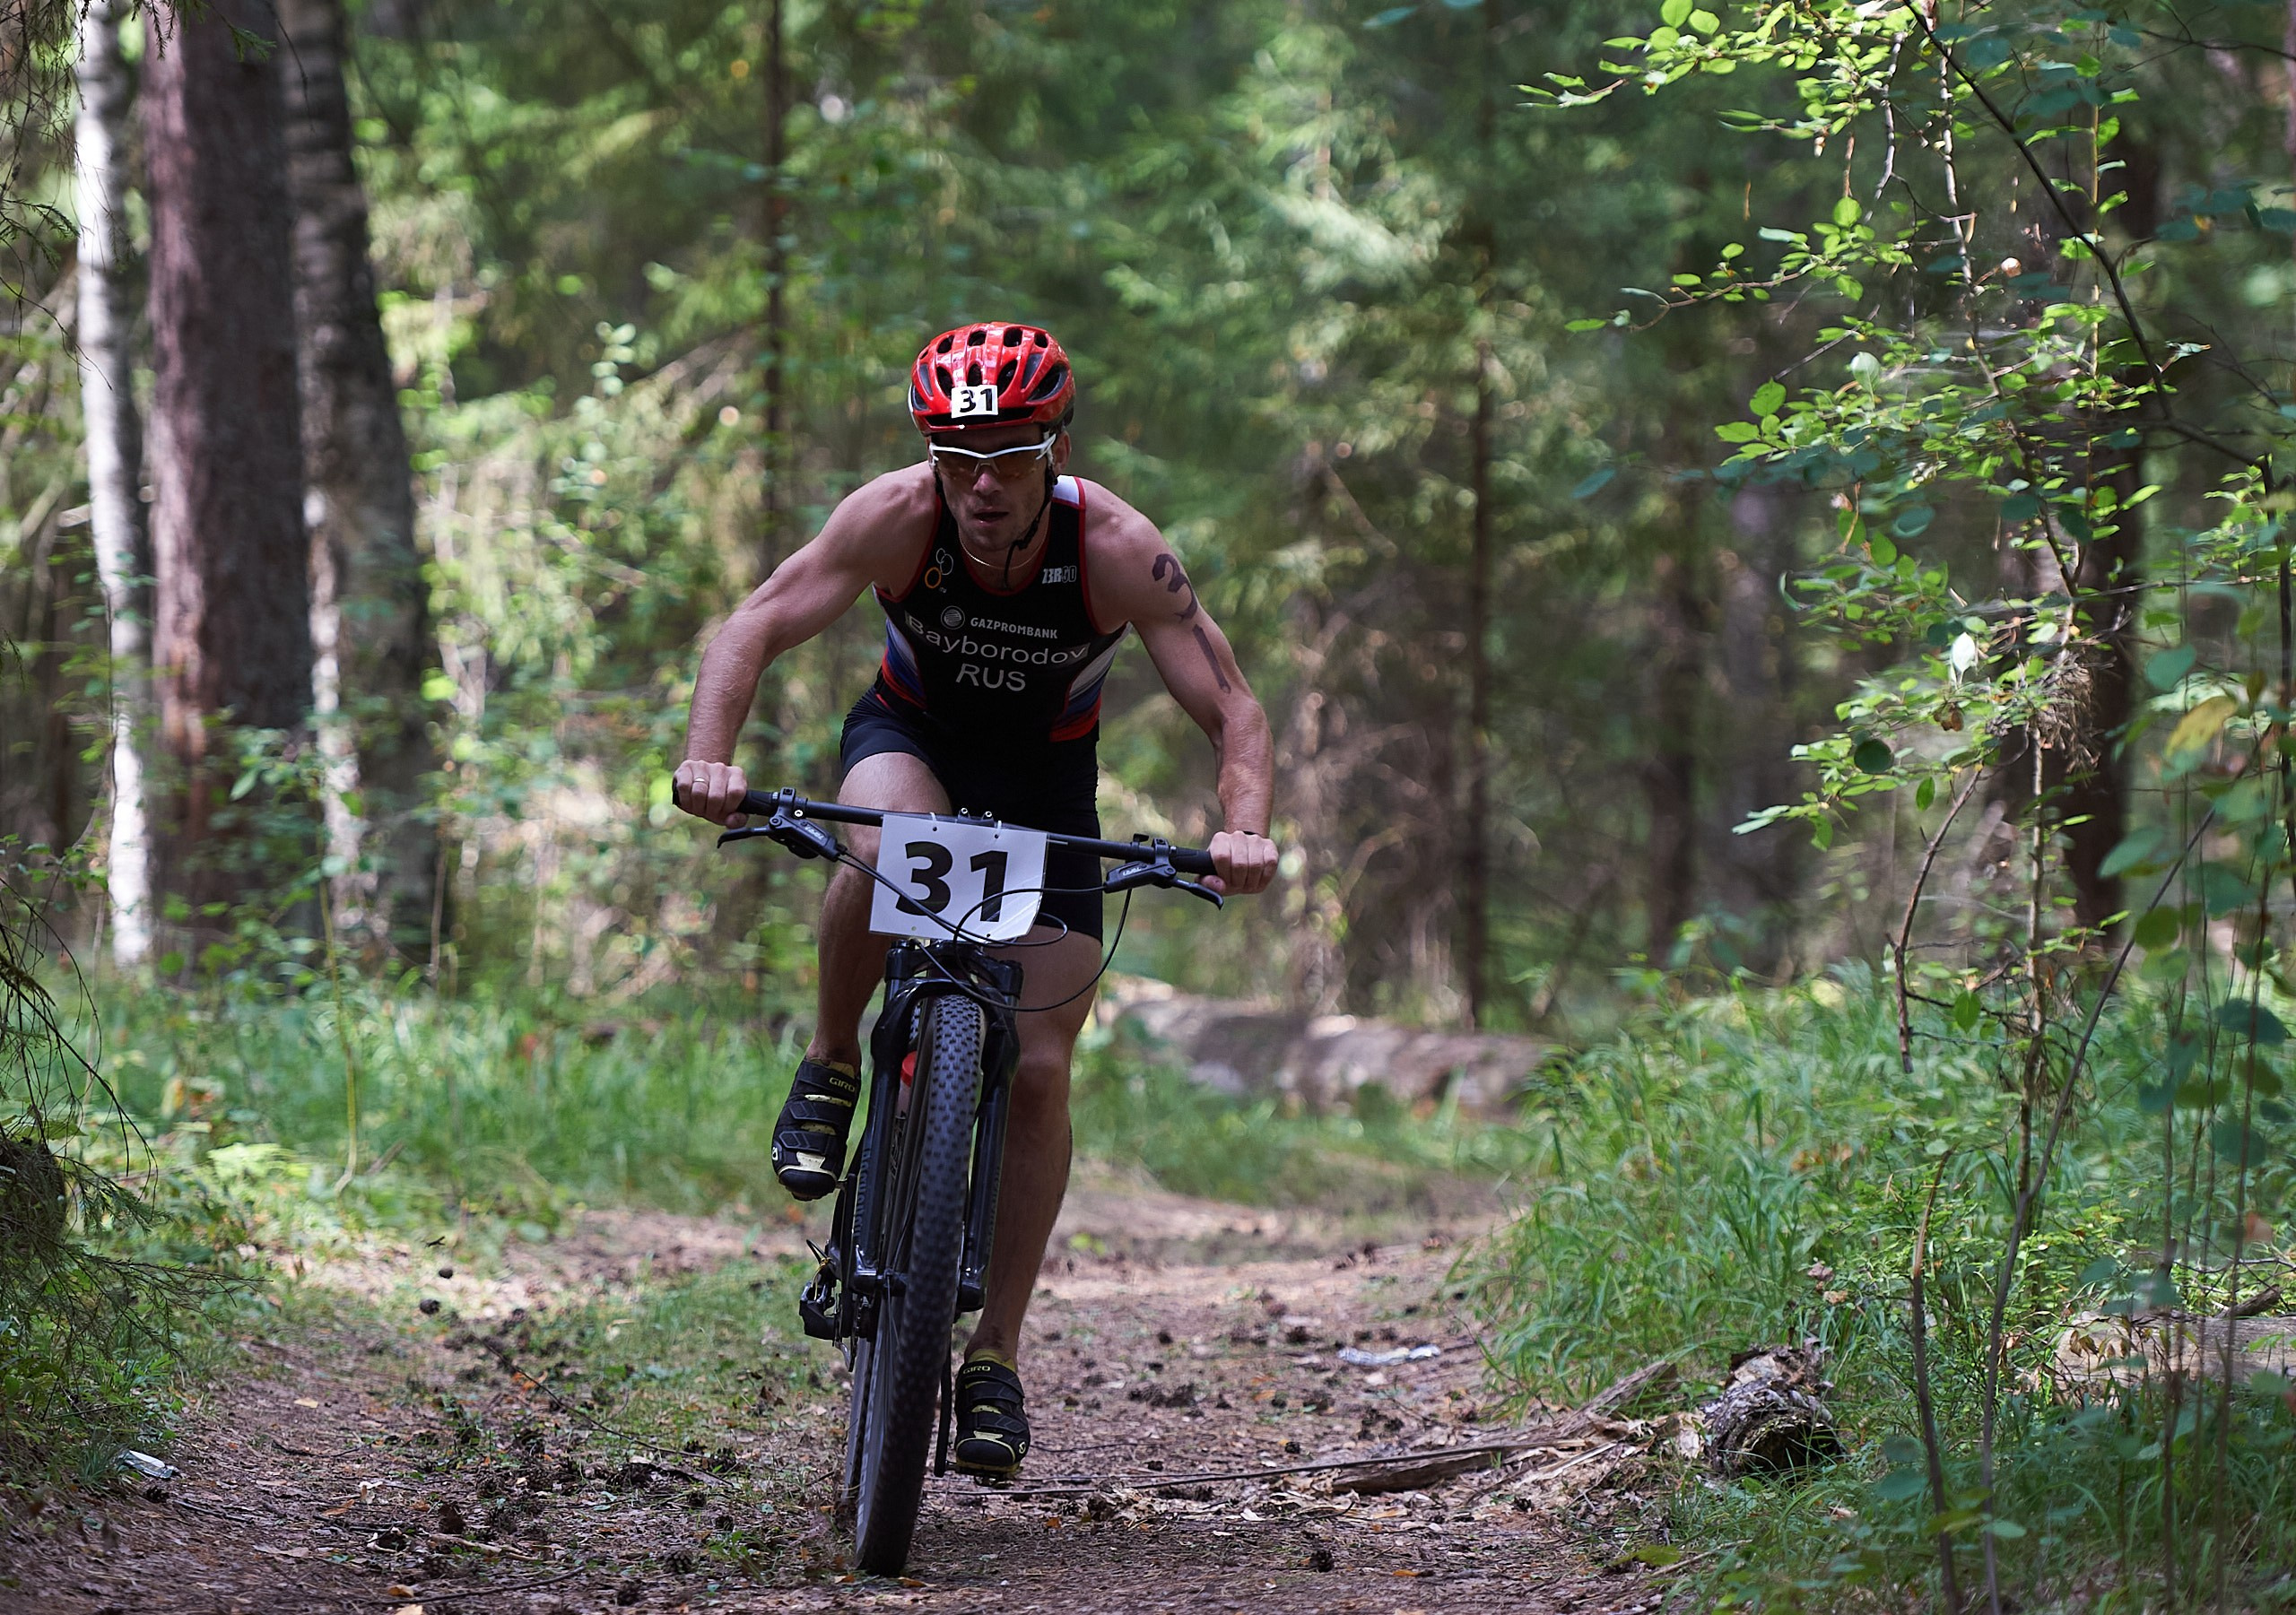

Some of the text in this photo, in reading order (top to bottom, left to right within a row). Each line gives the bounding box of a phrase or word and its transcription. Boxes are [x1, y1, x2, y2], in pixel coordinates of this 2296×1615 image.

[959, 387, 994, 413] 31
[970, 616, 1058, 639] GAZPROMBANK
[1152, 553, 1231, 695] 31
[908, 614, 1087, 665] Bayborodov
[955, 663, 1026, 692] RUS
[895, 840, 1008, 923] 31
[829, 1076, 857, 1093] GIRO
[962, 1365, 991, 1375] GIRO
